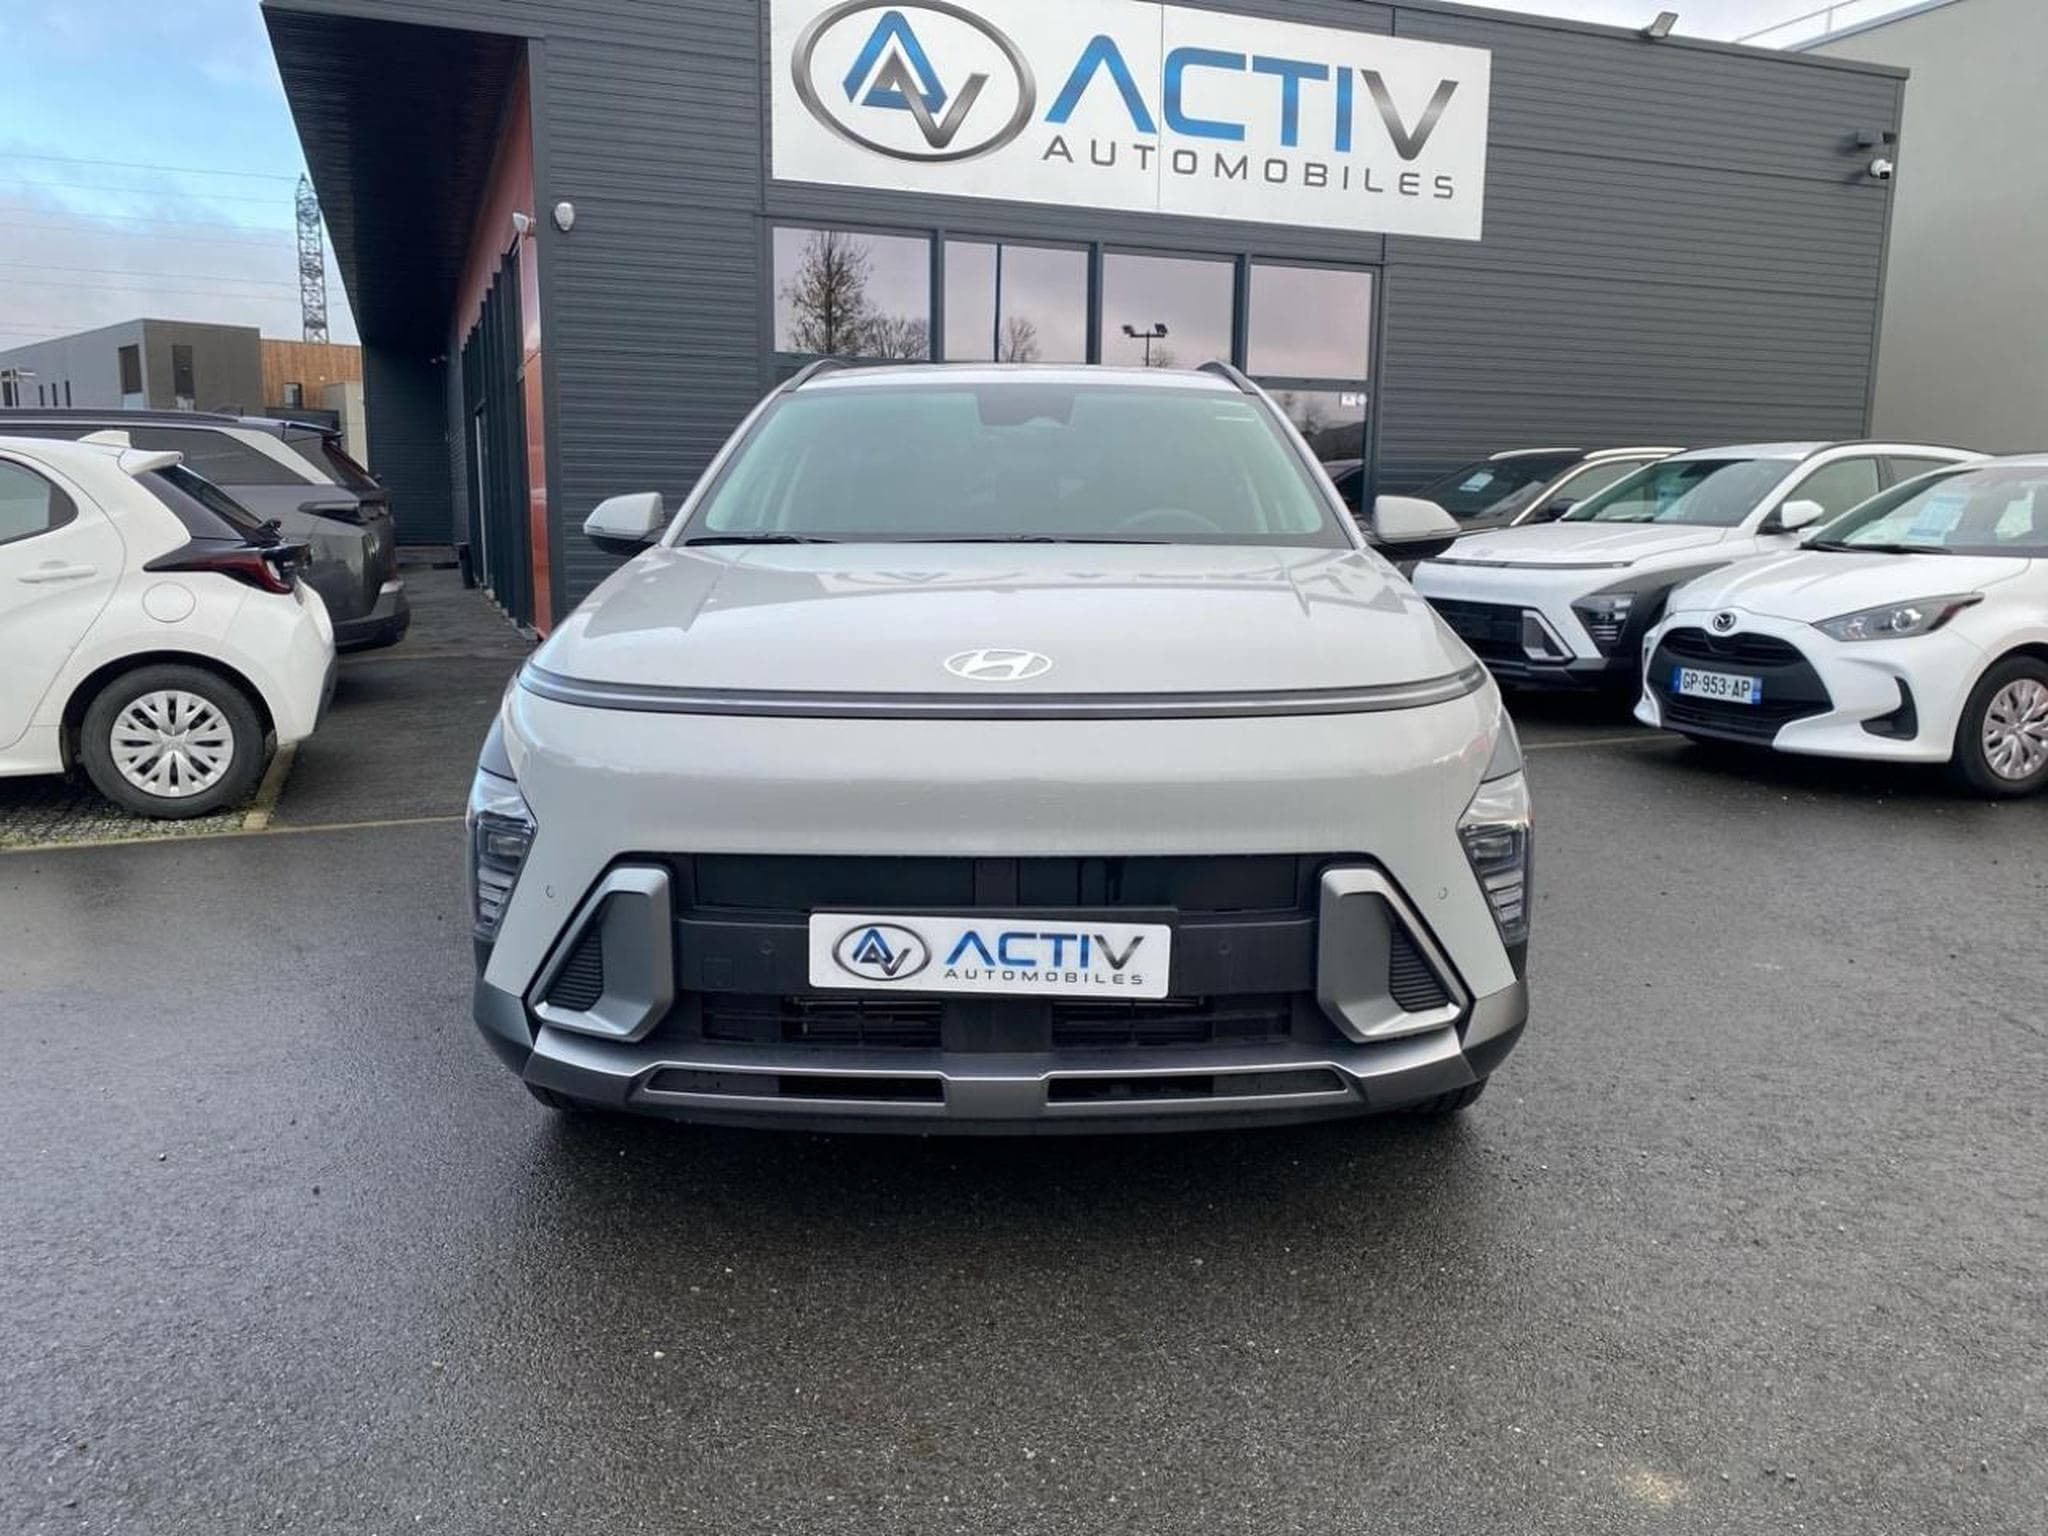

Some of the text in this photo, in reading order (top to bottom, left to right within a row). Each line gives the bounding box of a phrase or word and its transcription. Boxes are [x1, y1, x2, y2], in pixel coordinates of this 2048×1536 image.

[1045, 34, 1458, 160] ACTIV
[1042, 135, 1454, 199] AUTOMOBILES
[945, 930, 1145, 970] ACTIV
[944, 969, 1144, 985] AUTOMOBILES
